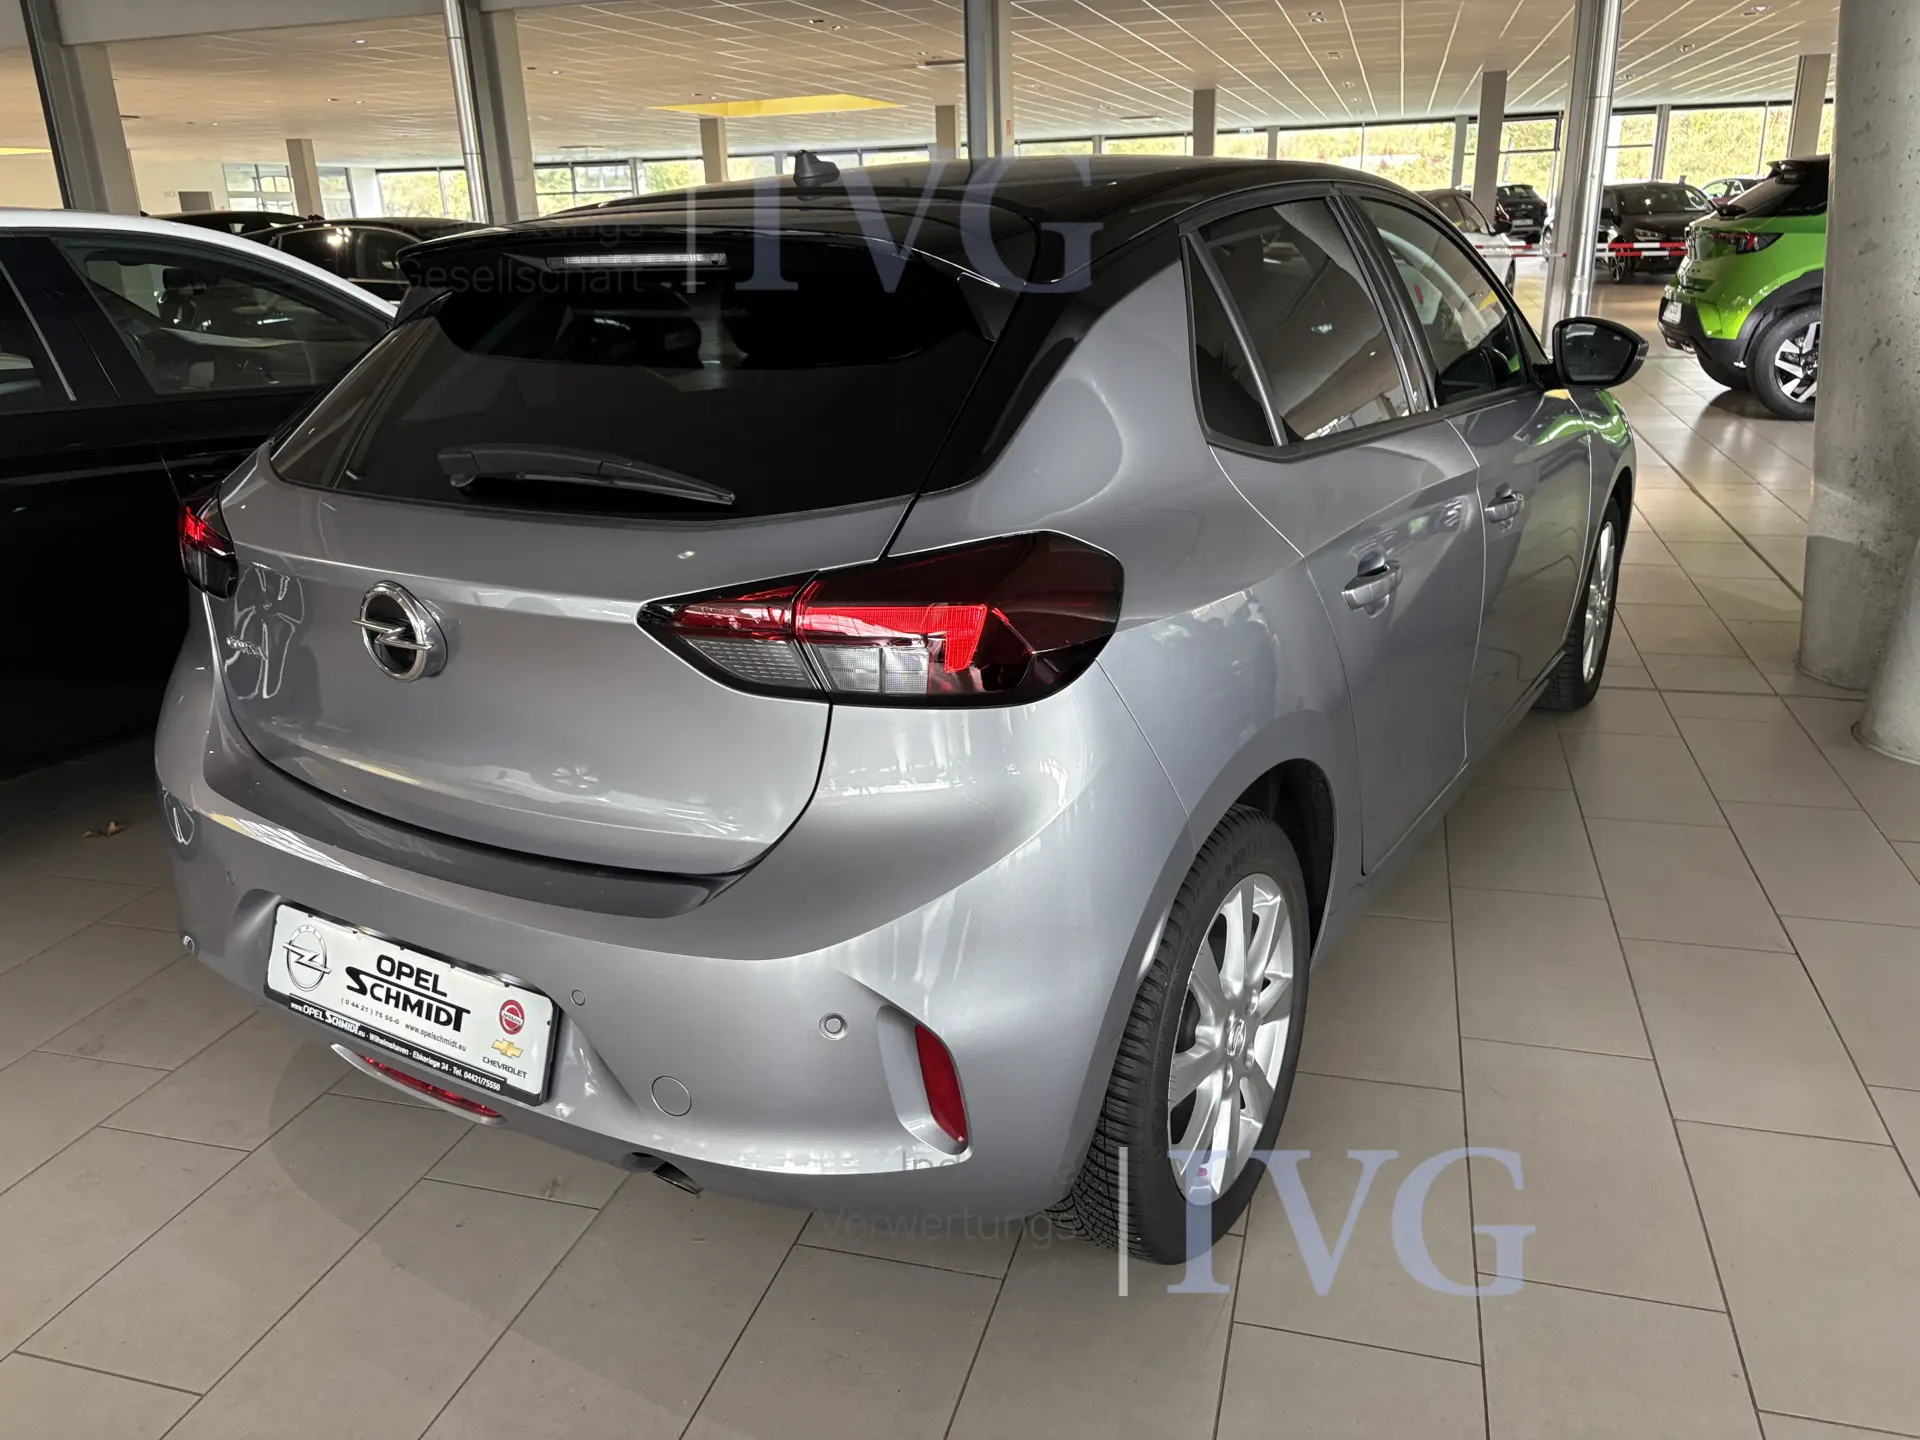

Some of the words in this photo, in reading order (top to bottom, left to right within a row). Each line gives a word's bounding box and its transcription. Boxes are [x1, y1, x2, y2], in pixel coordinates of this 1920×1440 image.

[376, 954, 447, 998] OPEL
[345, 966, 471, 1033] SCHMIDT
[405, 1023, 467, 1052] www.opelschmidt.eu
[369, 1033, 409, 1056] Wilhelmshaven
[441, 1062, 449, 1072] 34
[464, 1071, 501, 1091] 04421/75550
[482, 1056, 528, 1079] CHEVROLET
